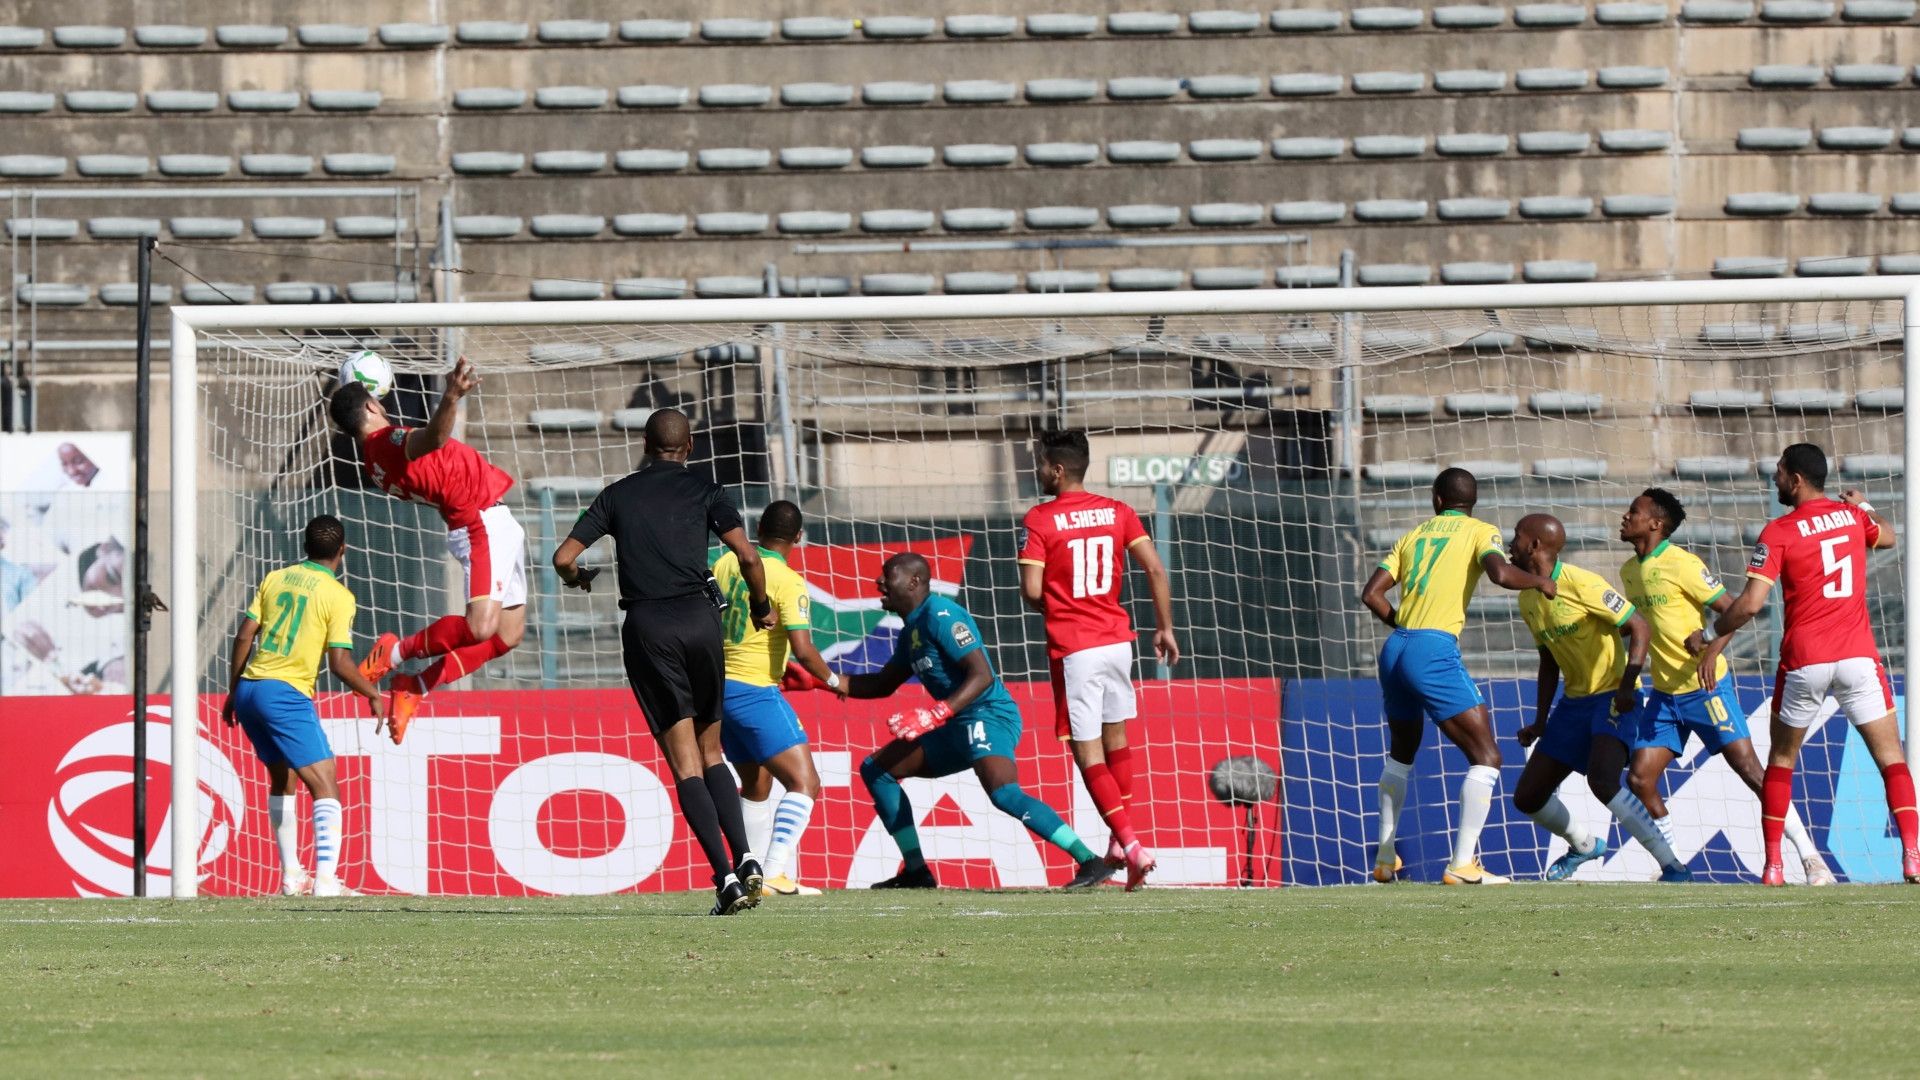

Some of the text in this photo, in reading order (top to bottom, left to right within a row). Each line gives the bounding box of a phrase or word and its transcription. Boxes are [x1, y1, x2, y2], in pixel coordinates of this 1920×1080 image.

[1115, 457, 1203, 483] BLOCK
[1053, 507, 1116, 531] M.SHERIF
[1796, 509, 1857, 538] R.RABIA
[1067, 535, 1114, 599] 10
[1407, 537, 1450, 597] 17
[1819, 534, 1853, 599] 5
[262, 591, 309, 657] 21
[1704, 695, 1728, 726] 18
[967, 720, 987, 745] 14
